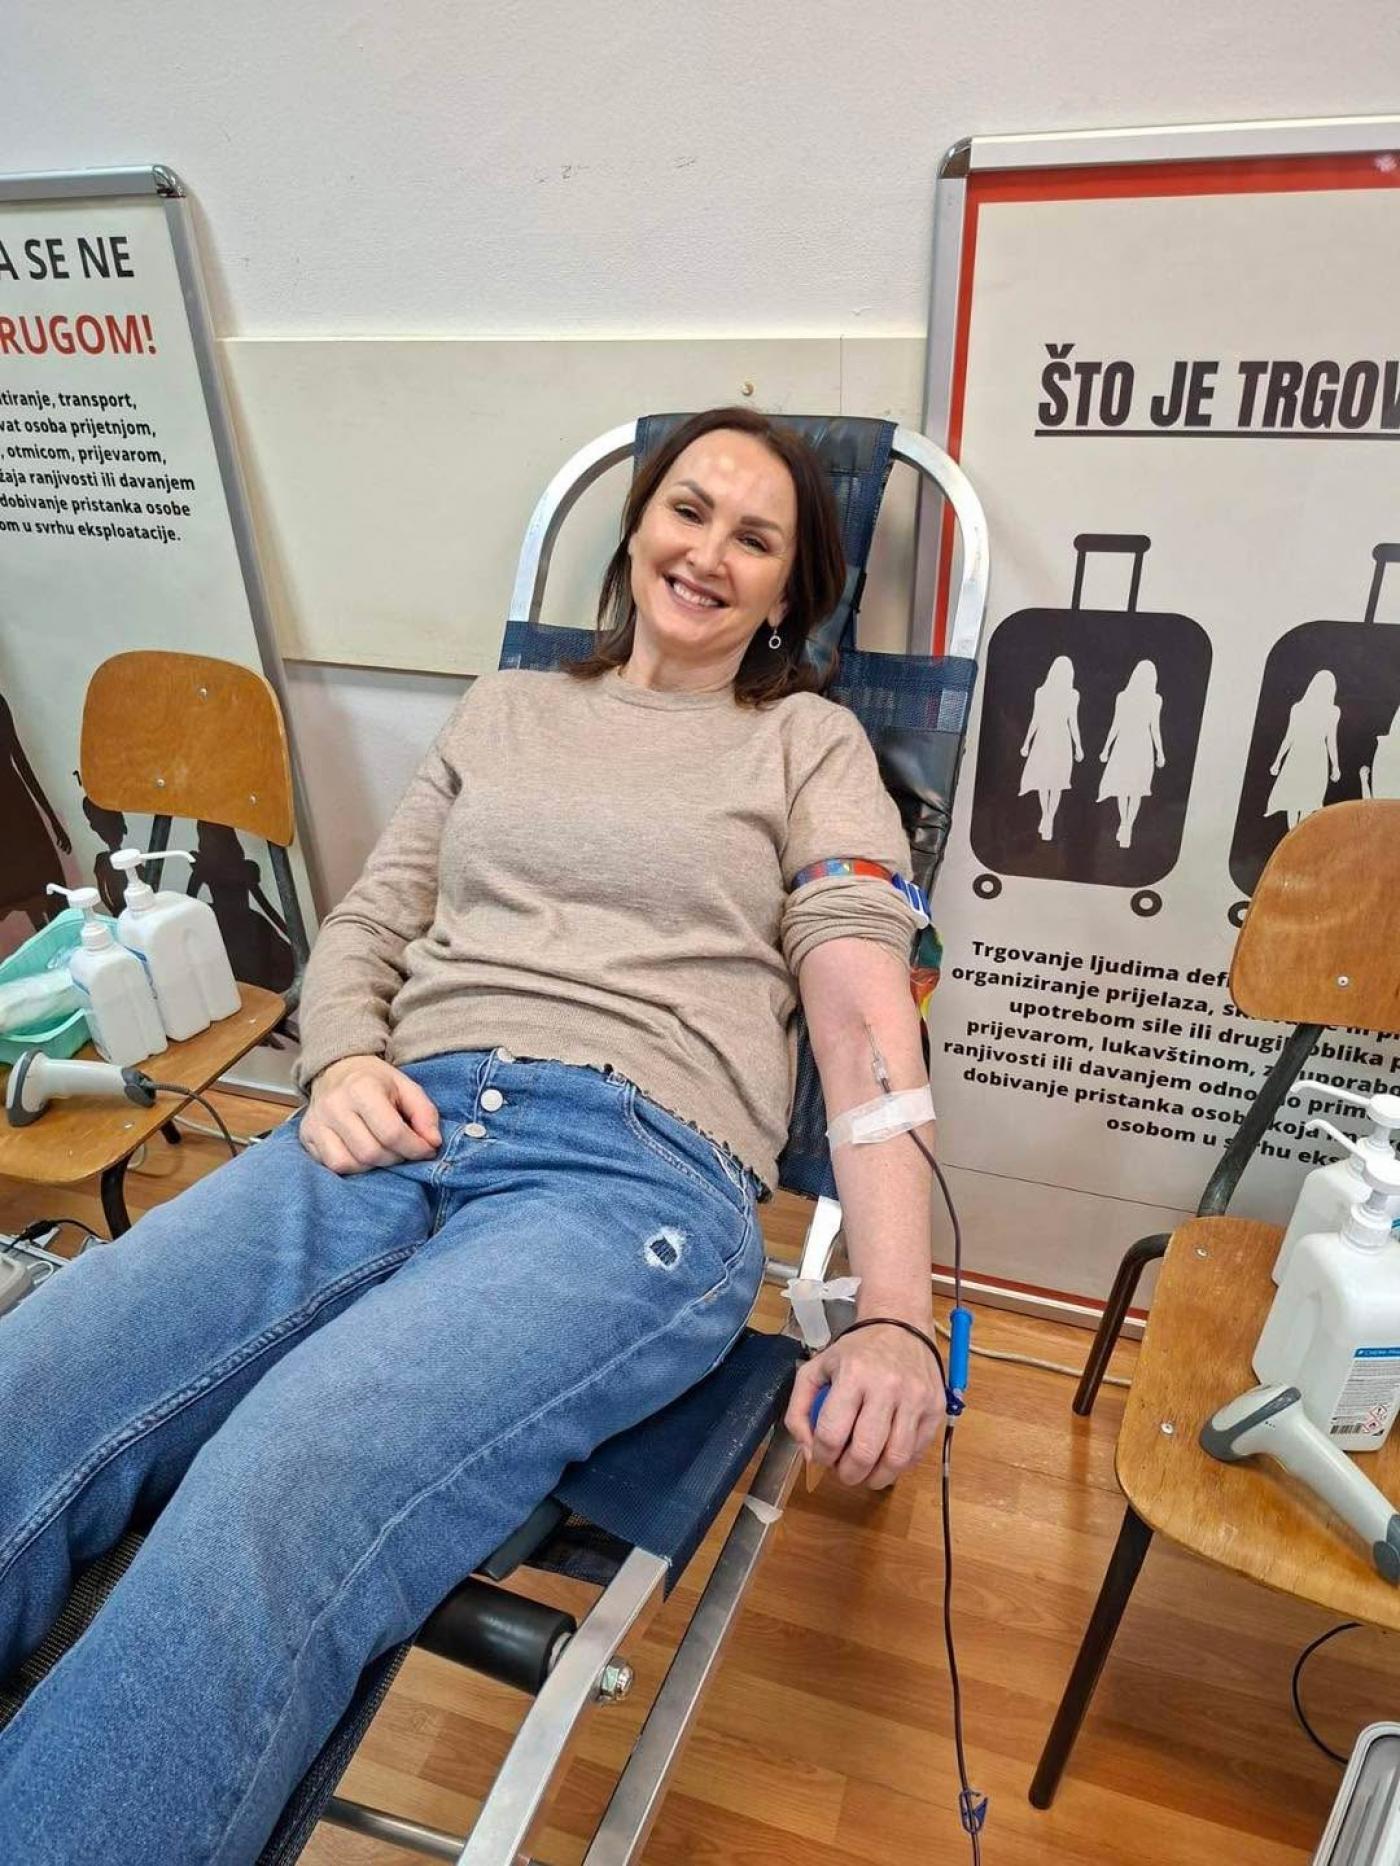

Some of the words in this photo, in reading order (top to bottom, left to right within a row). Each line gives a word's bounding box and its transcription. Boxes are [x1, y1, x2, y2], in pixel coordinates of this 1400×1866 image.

[25, 239, 69, 280] SE
[78, 237, 134, 278] NE
[0, 315, 156, 354] RUGOM!
[58, 393, 136, 411] transport,
[1039, 344, 1134, 426] ŠTO
[1151, 362, 1218, 426] JE
[24, 418, 67, 433] osoba
[70, 418, 156, 438] prijetnjom,
[7, 444, 74, 462] otmicom,
[78, 445, 166, 465] prijevarom,
[30, 470, 98, 488] ranjivosti
[101, 472, 116, 487] ili
[120, 473, 195, 494] davanjem
[71, 497, 142, 514] pristanka
[146, 501, 190, 516] osobe
[22, 522, 32, 532] u
[35, 520, 74, 534] svrhu
[78, 522, 180, 544] eksploatacije.
[972, 942, 1083, 971] Trgovanje
[1090, 955, 1178, 981] ljudima
[952, 968, 1099, 999] organiziranje
[1106, 988, 1213, 1016] prijelaza,
[1010, 1002, 1134, 1029] upotrebom
[1142, 1018, 1182, 1036] sile
[1190, 1022, 1212, 1040] ili
[1218, 1028, 1290, 1054] drugi
[944, 1042, 1046, 1067] ranjivosti
[1053, 1056, 1072, 1071] ili
[1080, 1060, 1191, 1090] davanjem
[967, 1021, 1093, 1051] prijevarom,
[1102, 1037, 1255, 1076] lukavštinom,
[964, 1068, 1068, 1098] dobivanje
[1075, 1088, 1184, 1115] pristanka
[1191, 1107, 1246, 1125] osob
[1107, 1119, 1195, 1142] osobom
[1203, 1134, 1216, 1146] u
